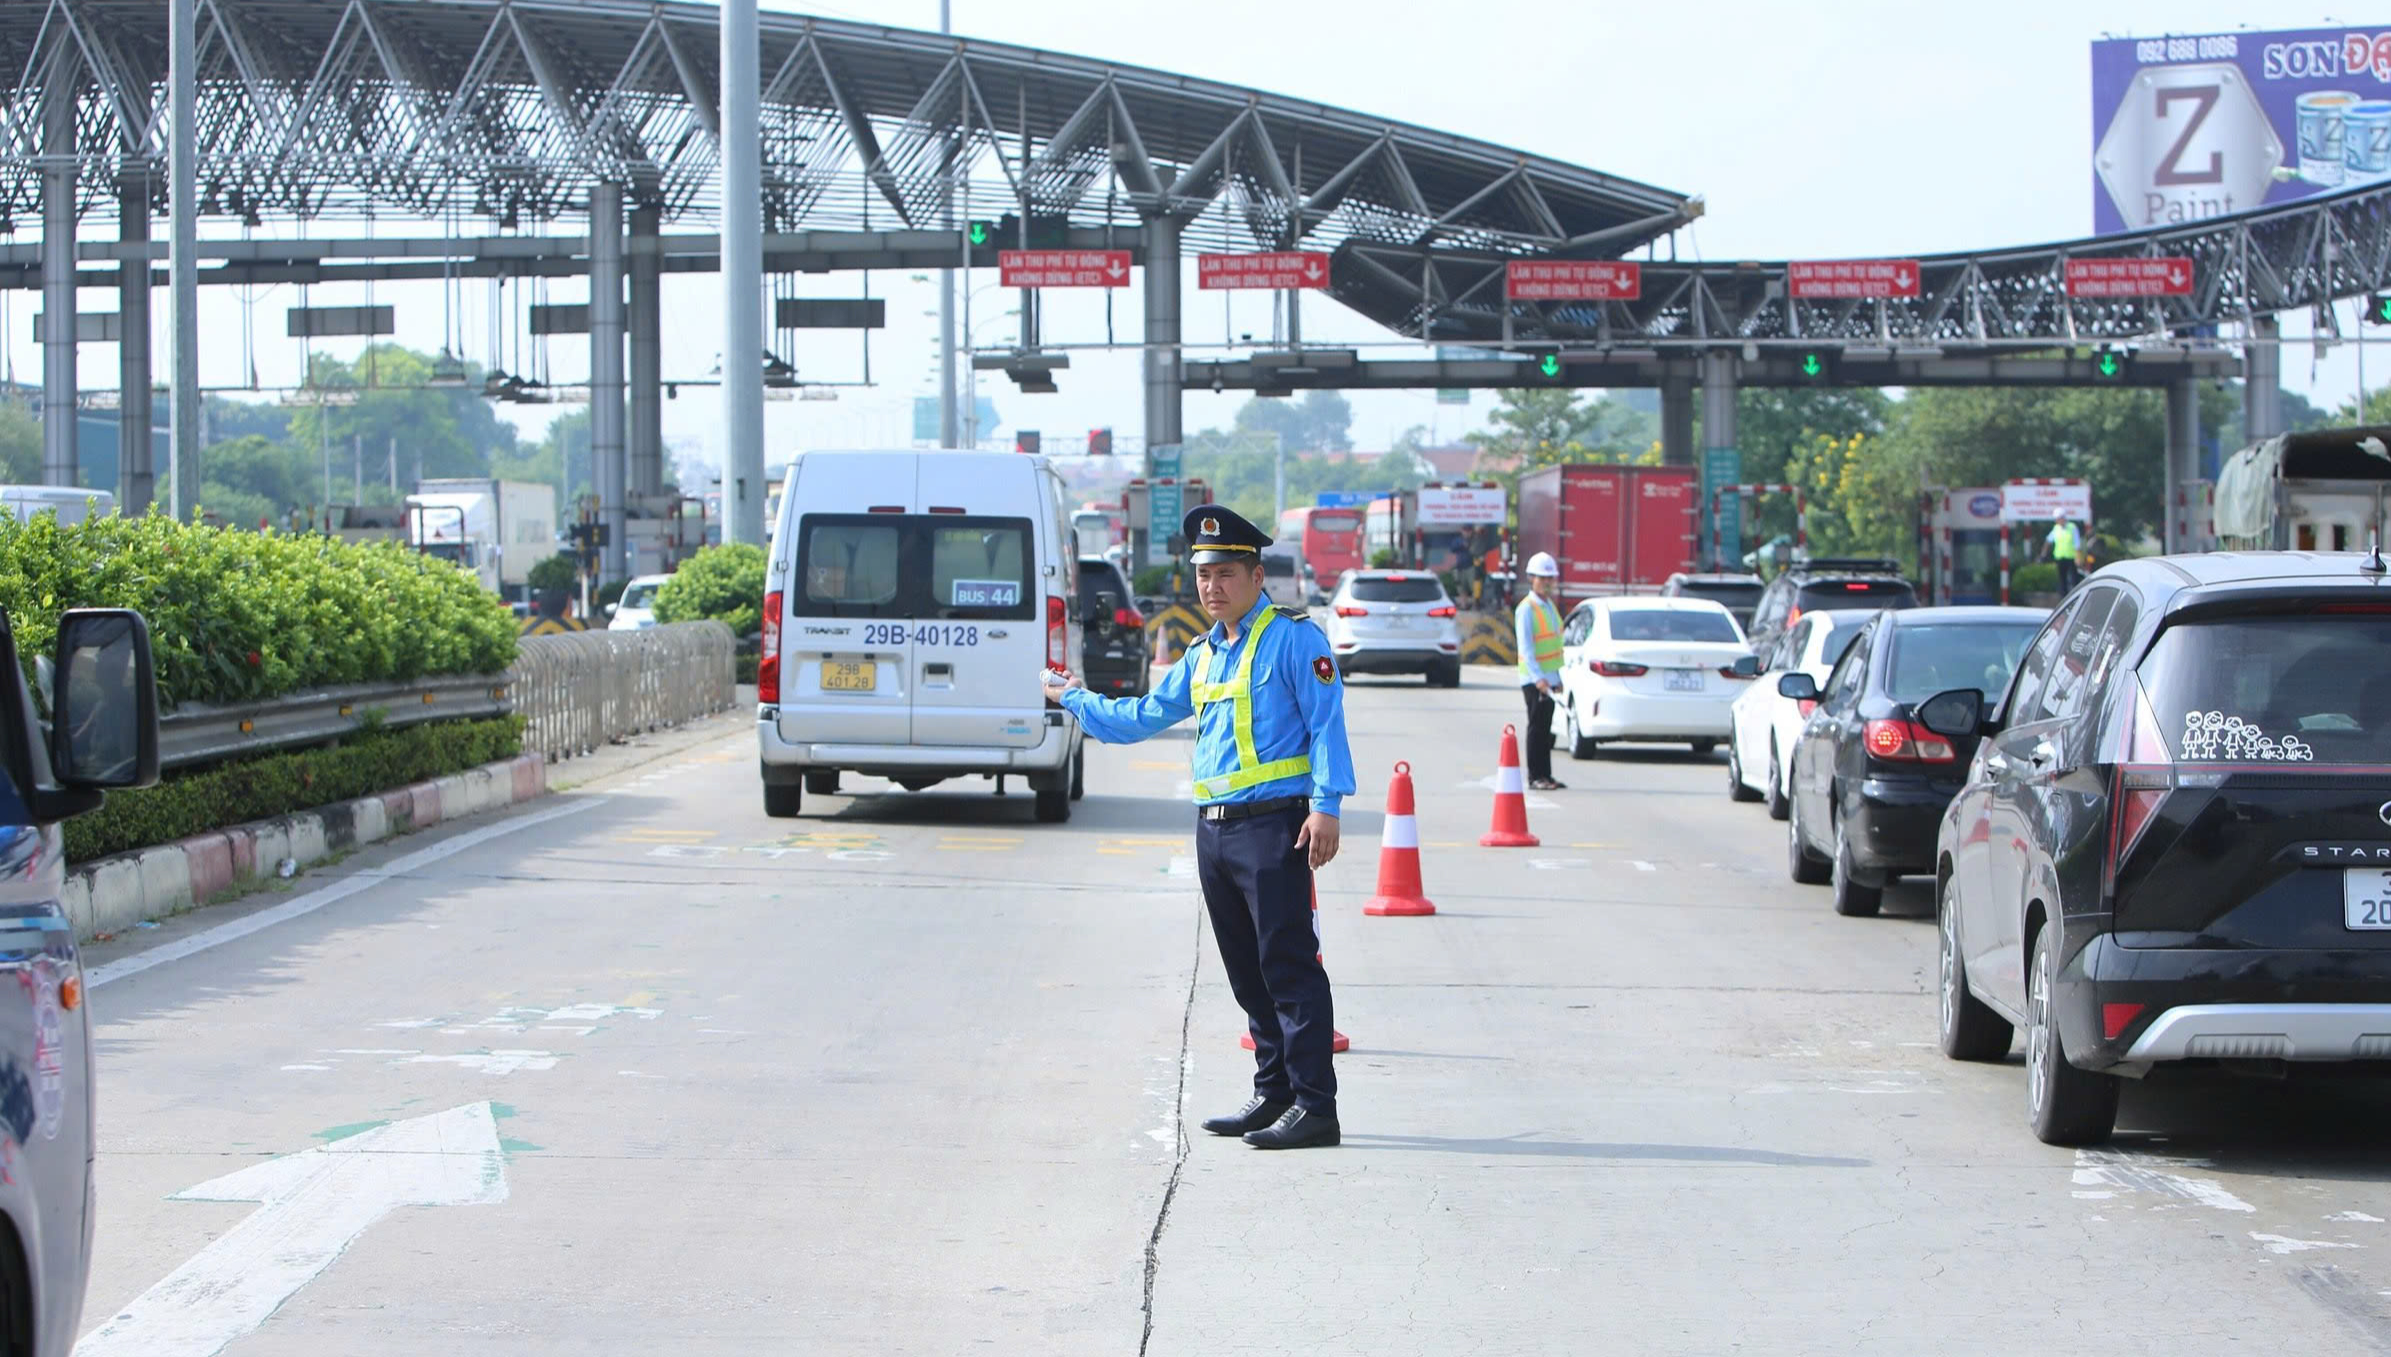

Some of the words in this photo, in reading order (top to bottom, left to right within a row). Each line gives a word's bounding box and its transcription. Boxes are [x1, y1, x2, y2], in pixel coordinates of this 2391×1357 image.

[2153, 85, 2223, 187] Z
[2143, 191, 2233, 224] Paint
[958, 590, 985, 603] BUS
[991, 588, 1015, 605] 44
[804, 626, 851, 635] TRANSIT
[864, 624, 978, 646] 29B-40128
[837, 663, 860, 675] 29B
[2304, 847, 2390, 857] STAR
